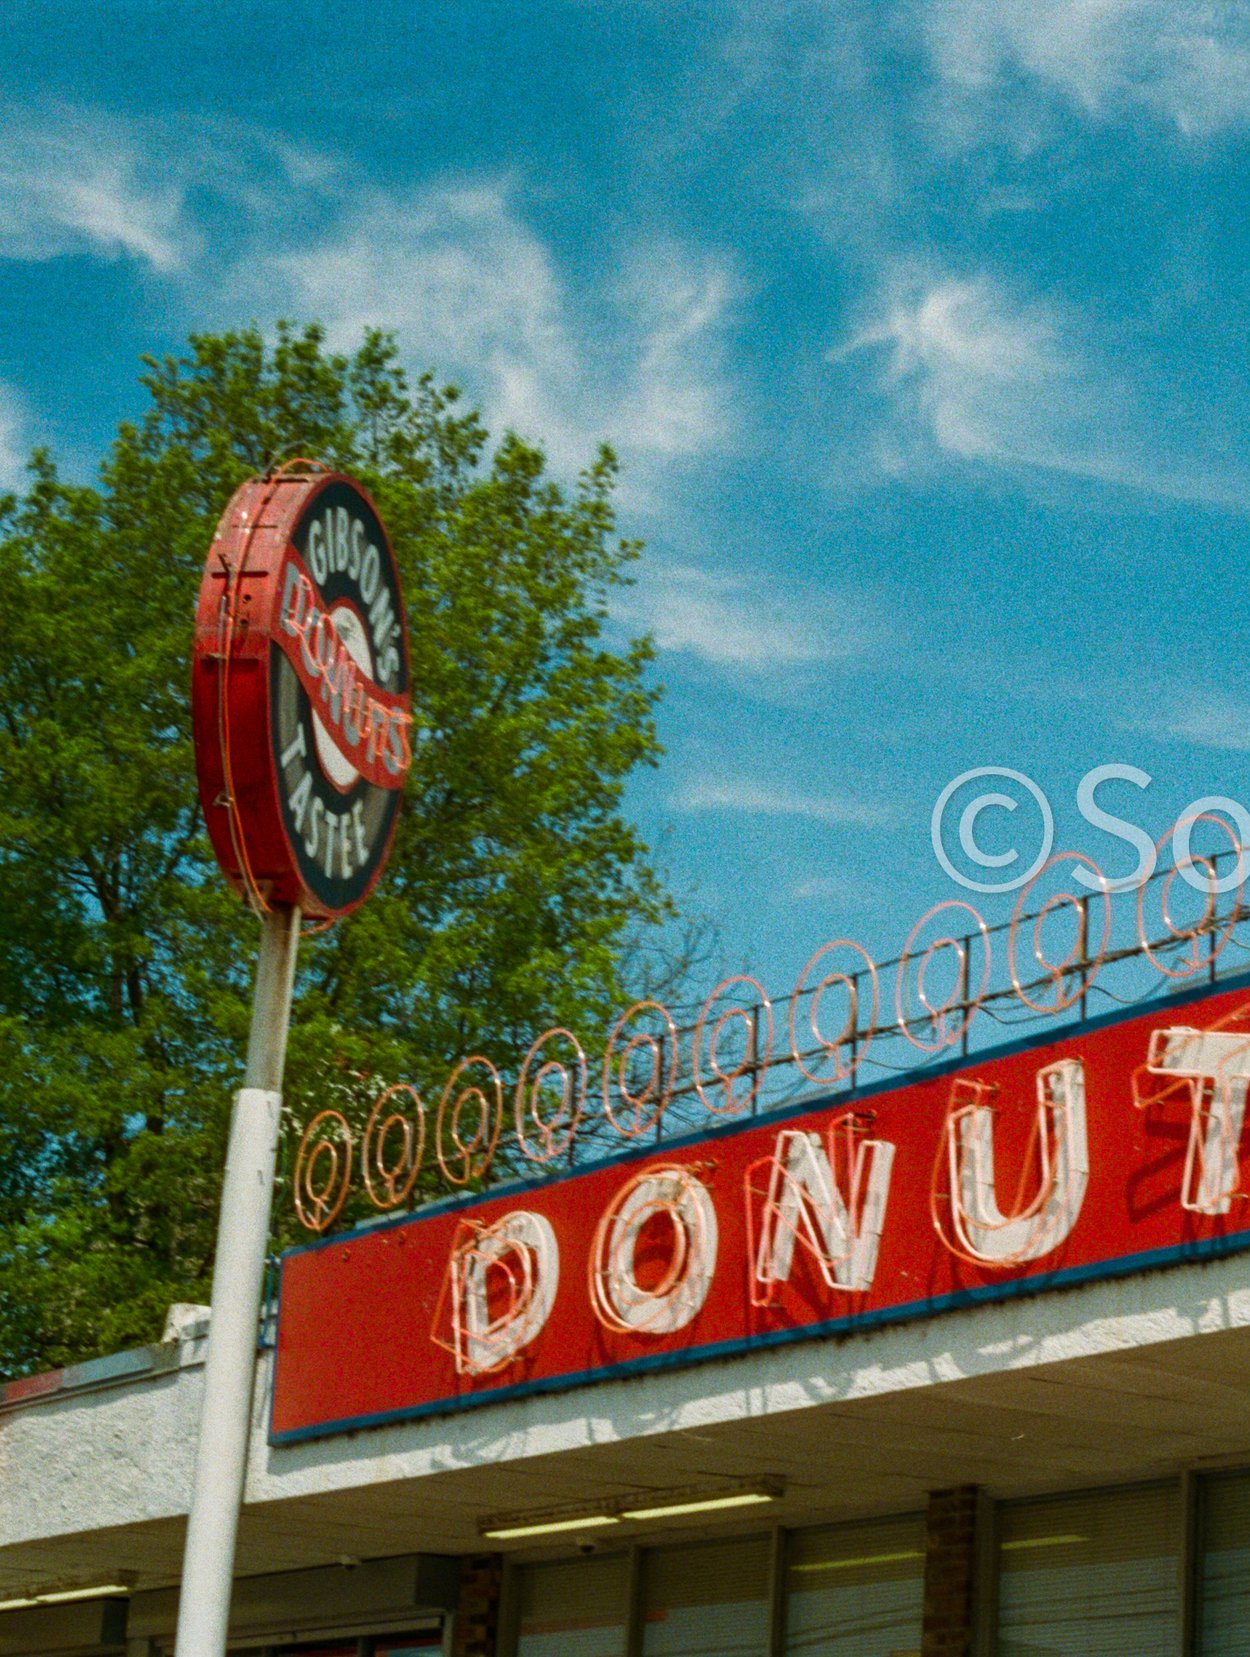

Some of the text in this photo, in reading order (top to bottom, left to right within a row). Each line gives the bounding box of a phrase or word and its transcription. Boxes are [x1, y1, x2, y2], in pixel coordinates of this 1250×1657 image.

[280, 561, 413, 776] DONUTS
[309, 506, 401, 683] GIBSON'S
[280, 723, 370, 880] TASTEE
